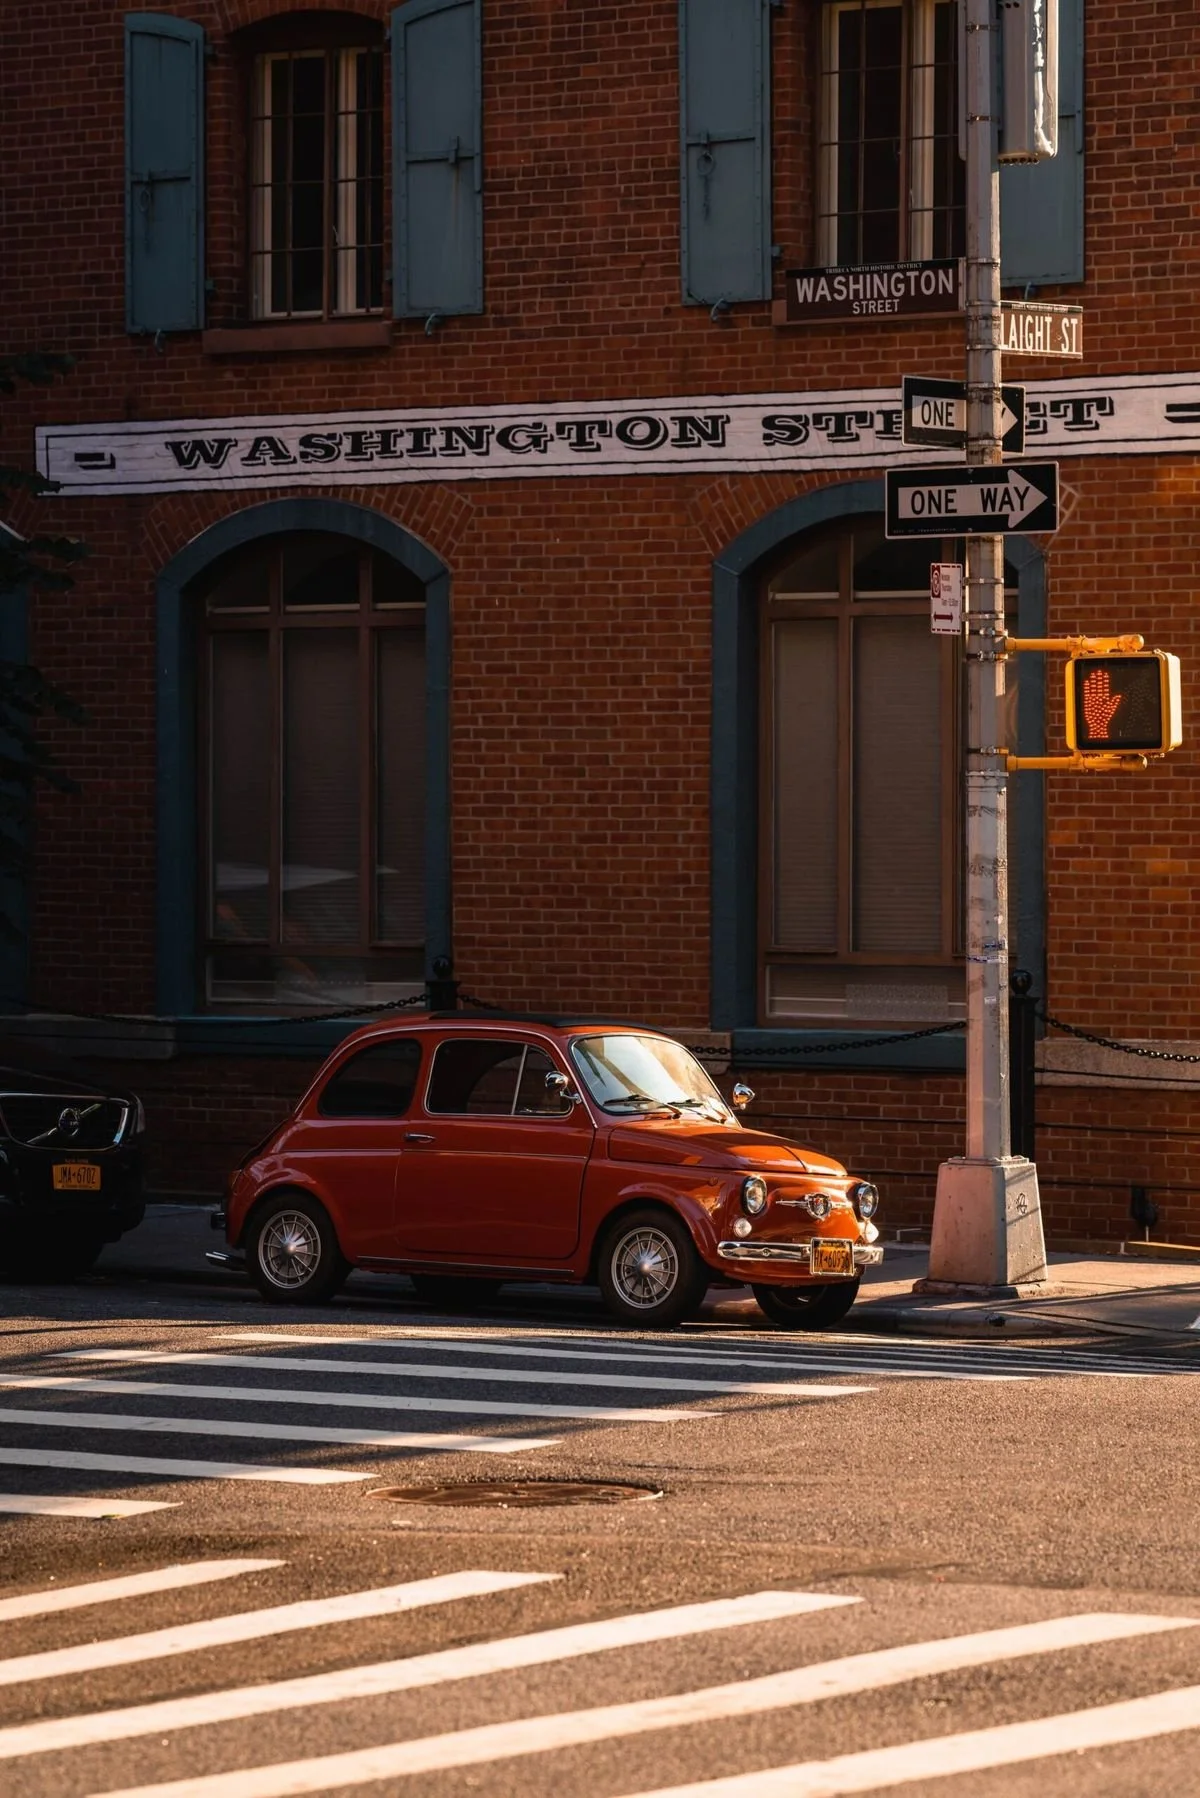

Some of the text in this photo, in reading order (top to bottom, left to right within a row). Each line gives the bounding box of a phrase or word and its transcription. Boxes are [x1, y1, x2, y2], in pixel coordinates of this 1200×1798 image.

[796, 269, 954, 303] WASHINGTON
[852, 299, 900, 314] STREET
[1000, 313, 1078, 353] LAIGHT ST
[921, 399, 955, 428] ONE
[165, 396, 1114, 470] WASHINGTON STT
[910, 486, 1030, 515] ONE WAY
